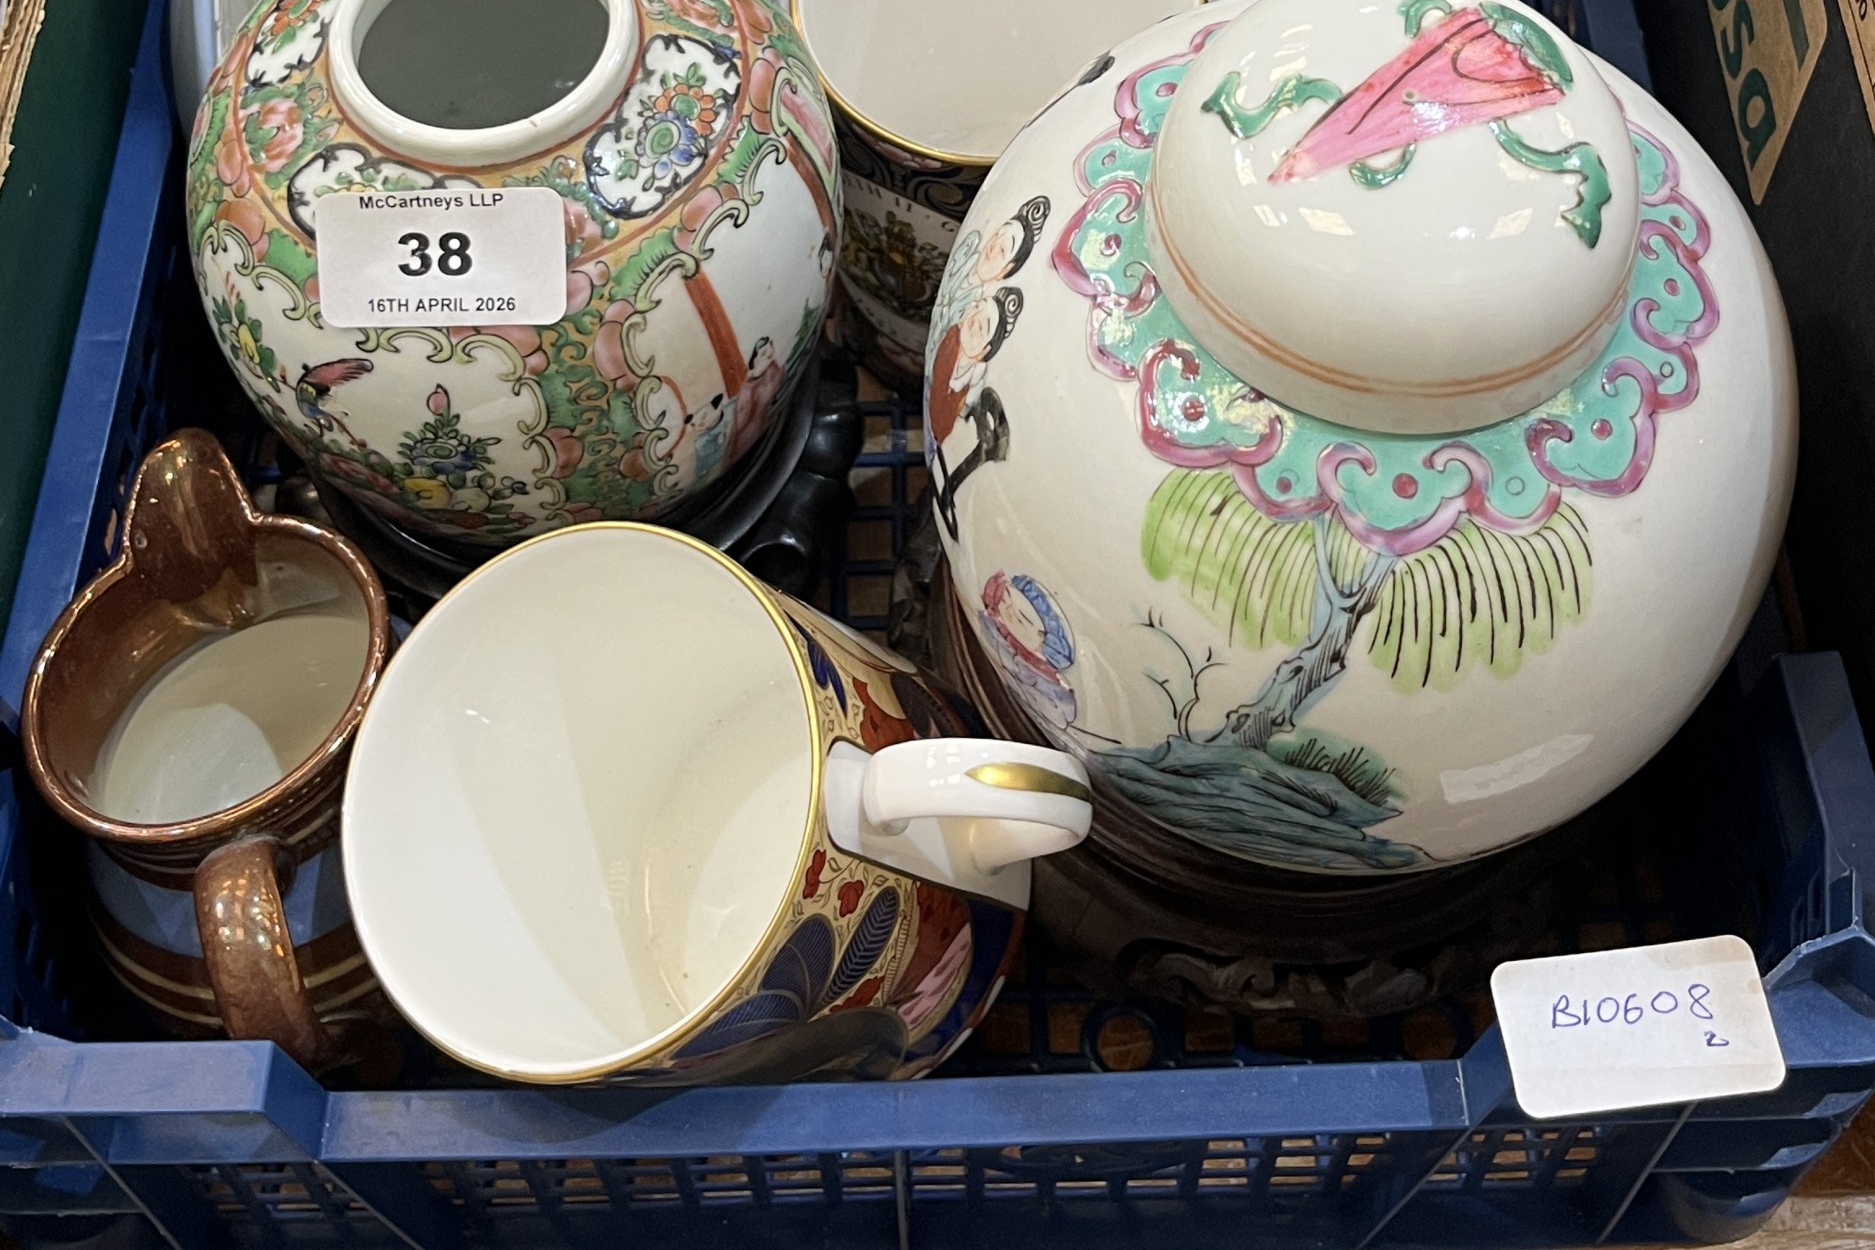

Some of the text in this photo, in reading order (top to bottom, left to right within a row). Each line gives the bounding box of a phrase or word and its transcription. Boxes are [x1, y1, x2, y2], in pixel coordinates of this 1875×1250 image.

[359, 193, 503, 210] McCartneys LLP
[398, 231, 473, 277] 38
[367, 296, 516, 312] 16TH APRIL 2026
